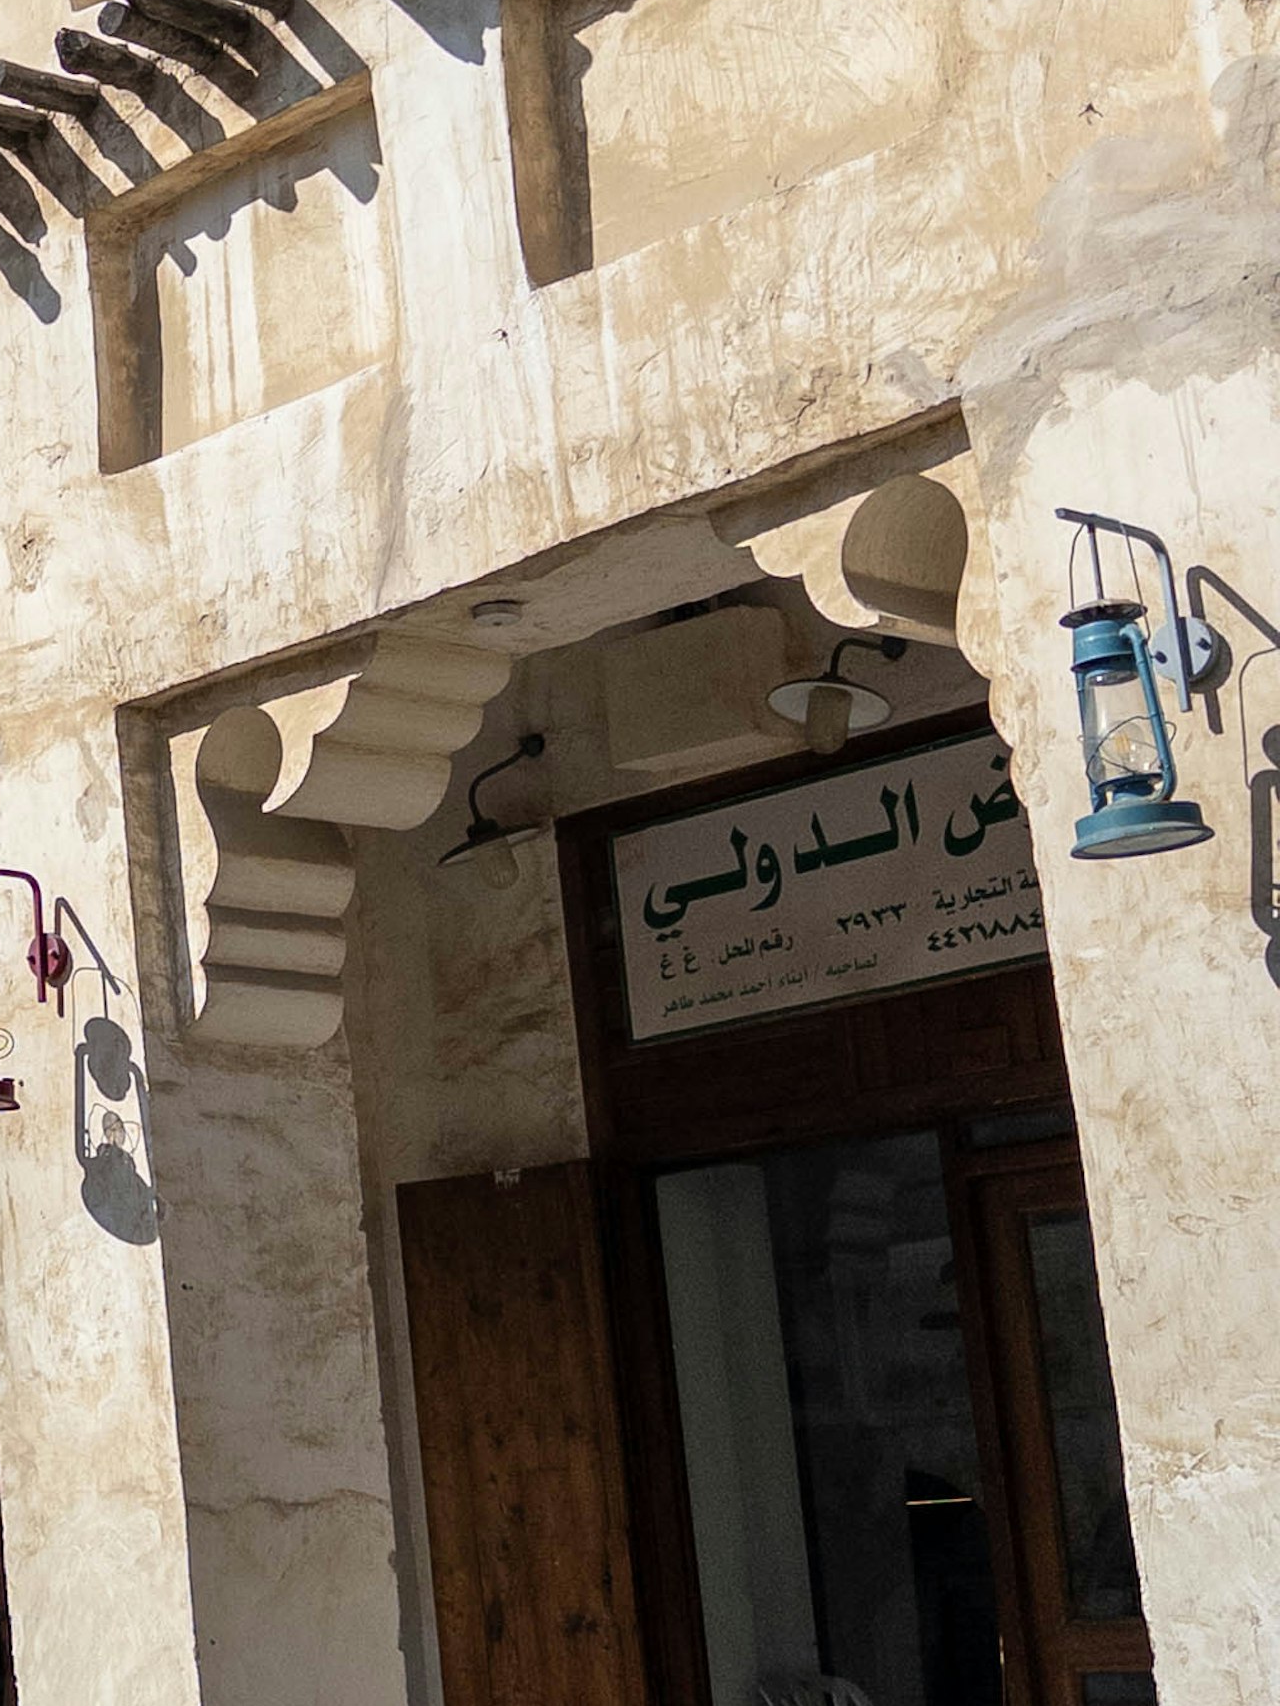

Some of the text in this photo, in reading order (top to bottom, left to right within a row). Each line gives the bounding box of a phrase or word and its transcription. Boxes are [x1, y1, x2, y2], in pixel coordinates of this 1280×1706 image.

[643, 778, 920, 944] الدولي
[931, 876, 1012, 916] التجارية
[836, 901, 907, 934] ٢٩٣٣
[719, 938, 755, 966] المحل
[759, 927, 794, 959] رقم
